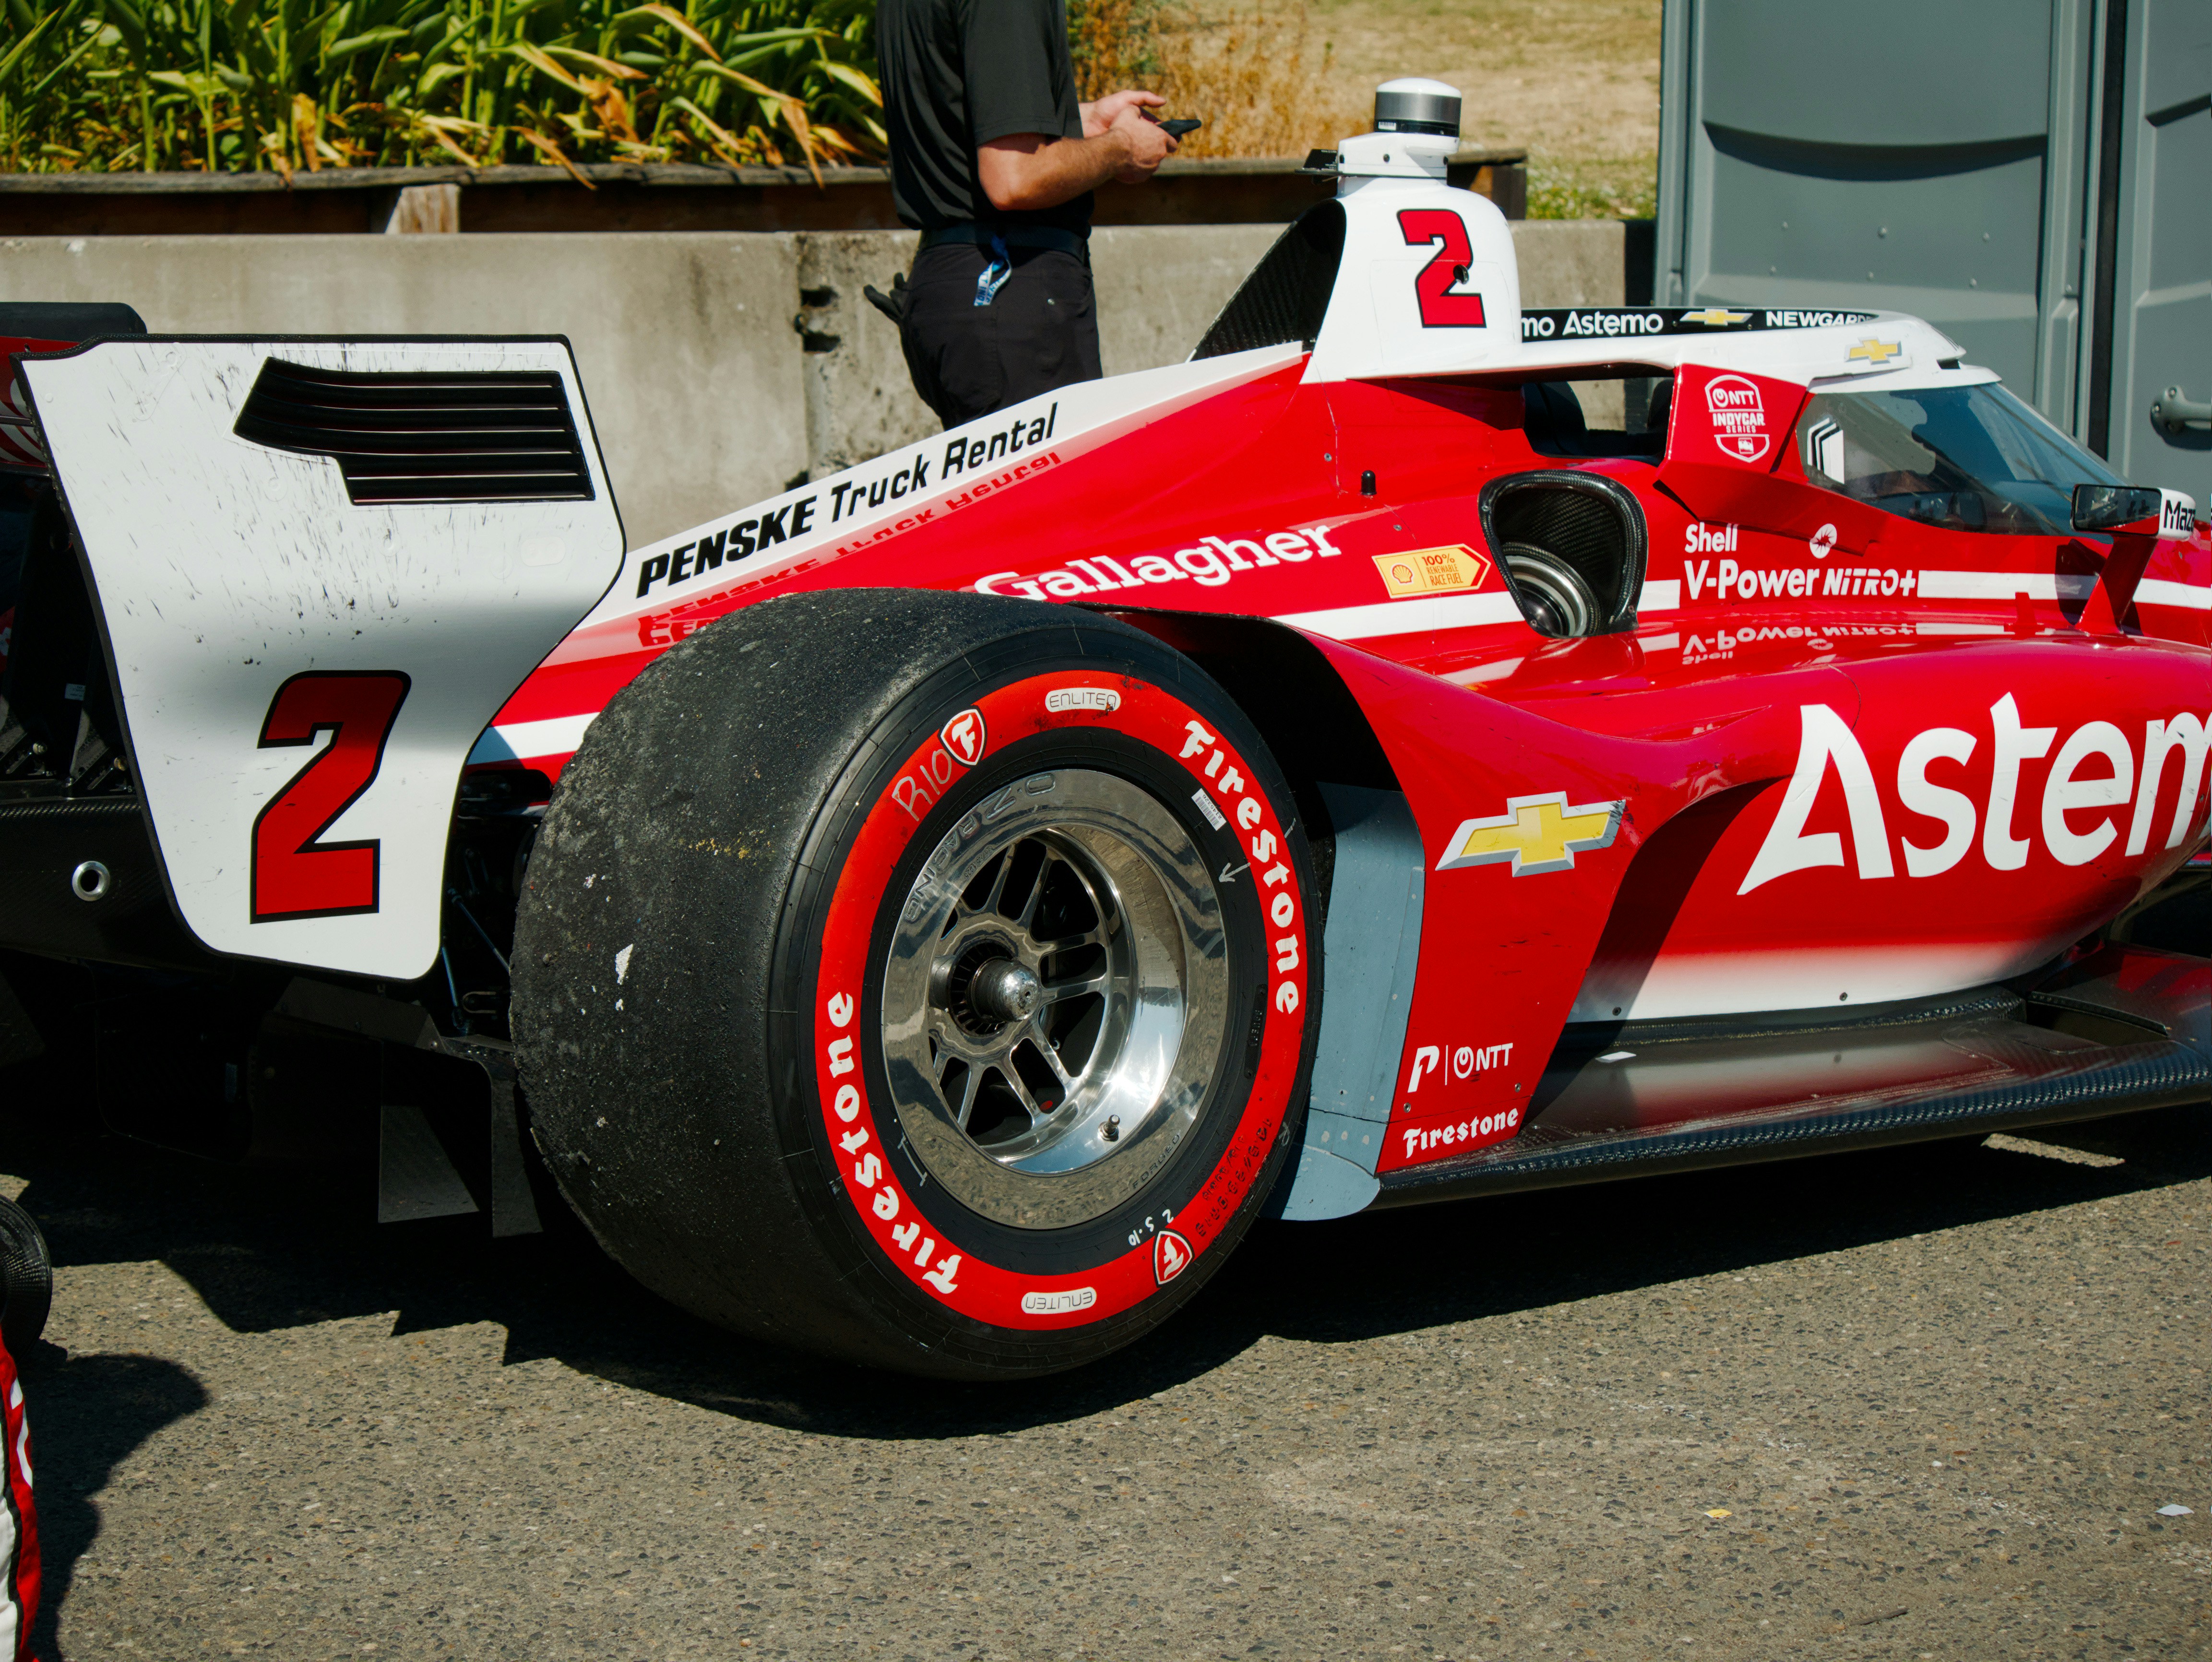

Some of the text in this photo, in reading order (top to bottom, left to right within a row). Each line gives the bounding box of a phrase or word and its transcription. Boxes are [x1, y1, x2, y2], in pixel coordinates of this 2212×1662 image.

[1397, 209, 1487, 328] 2
[1562, 311, 1663, 335] Astemo
[1728, 390, 1754, 405] NTT
[1713, 413, 1765, 427] INDYCAR
[636, 403, 1058, 599] PENSKE Truck Rental
[1685, 522, 1738, 553] Shell
[974, 525, 1342, 601] Gallagher
[1421, 554, 1455, 566] 100%
[1426, 564, 1459, 575] RENEWABLE
[1429, 572, 1463, 586] RACE FUEL
[1684, 559, 1820, 599] V-Power
[250, 670, 411, 924] 2
[1178, 721, 1299, 1014] Firestone
[1476, 1043, 1513, 1071] NTT
[828, 992, 962, 1294] Firestone
[1403, 1108, 1518, 1158] Firestone
